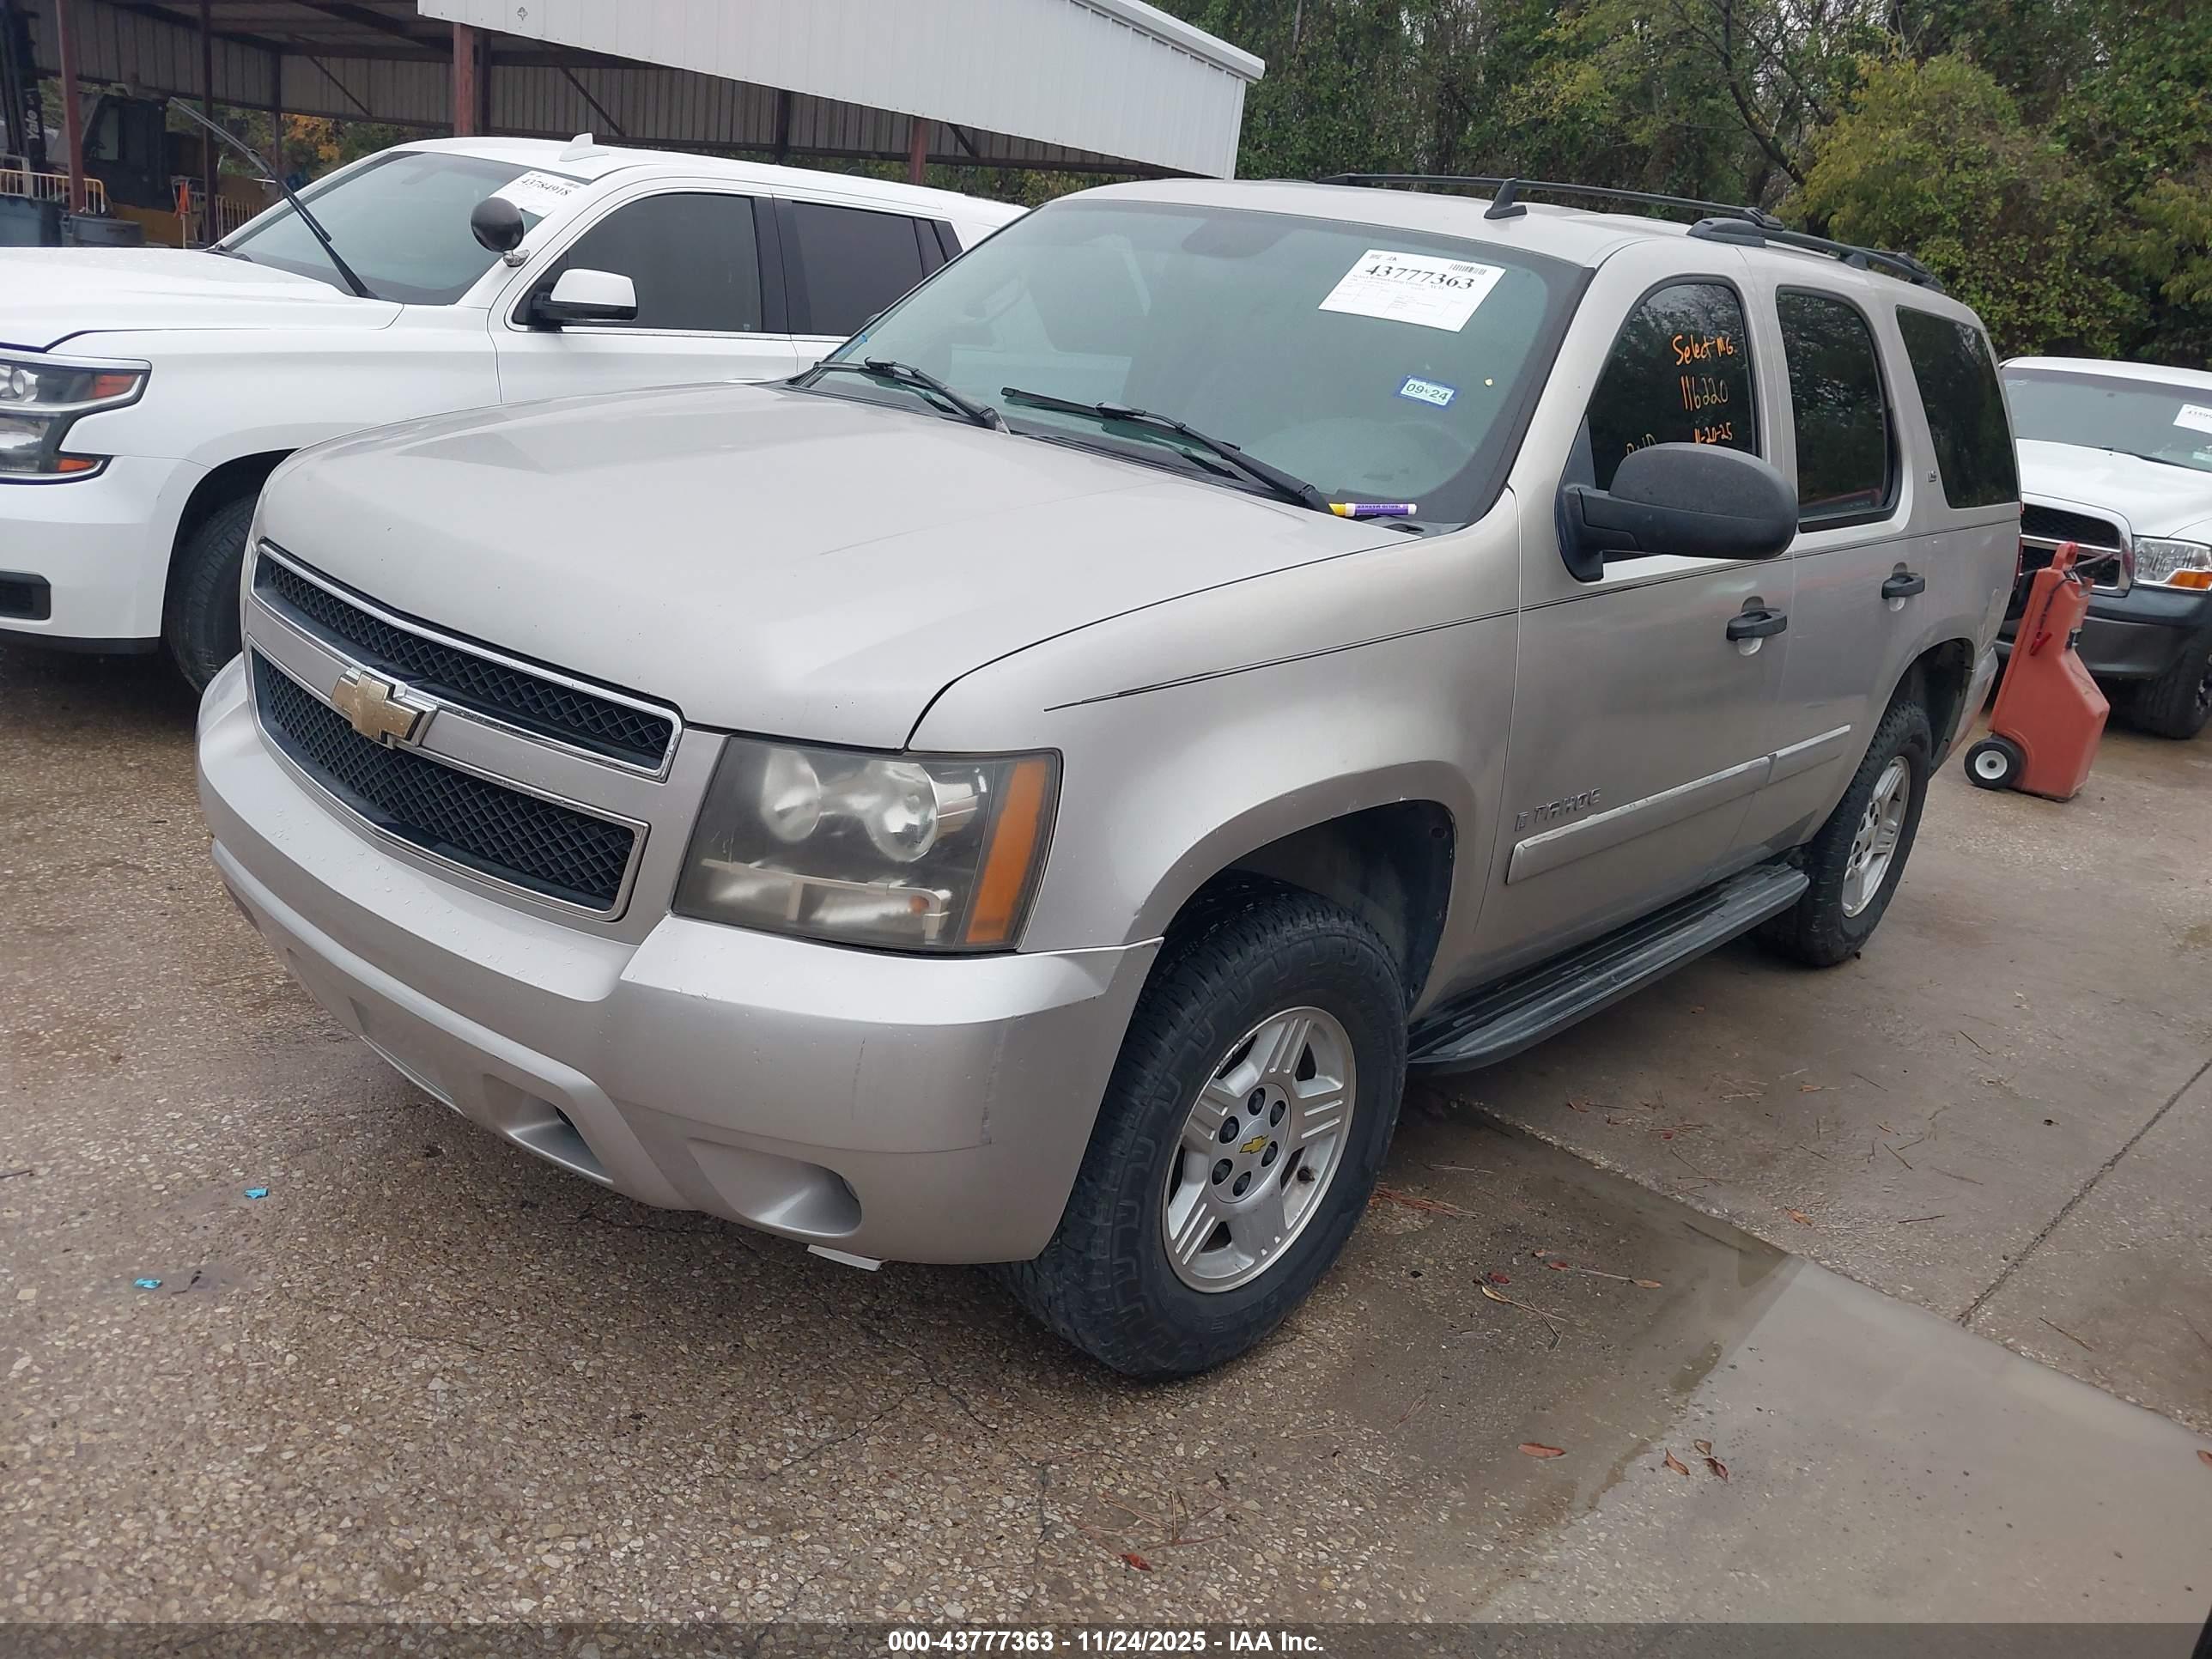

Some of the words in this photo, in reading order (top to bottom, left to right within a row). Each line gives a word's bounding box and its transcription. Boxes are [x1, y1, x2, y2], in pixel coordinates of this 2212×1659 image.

[25, 109, 40, 139] Yale
[521, 178, 573, 196] 43784918
[1364, 264, 1475, 290] 43777363
[1672, 334, 1716, 366] Select
[1680, 375, 1729, 411] 116220
[1533, 787, 1601, 823] TAHOE
